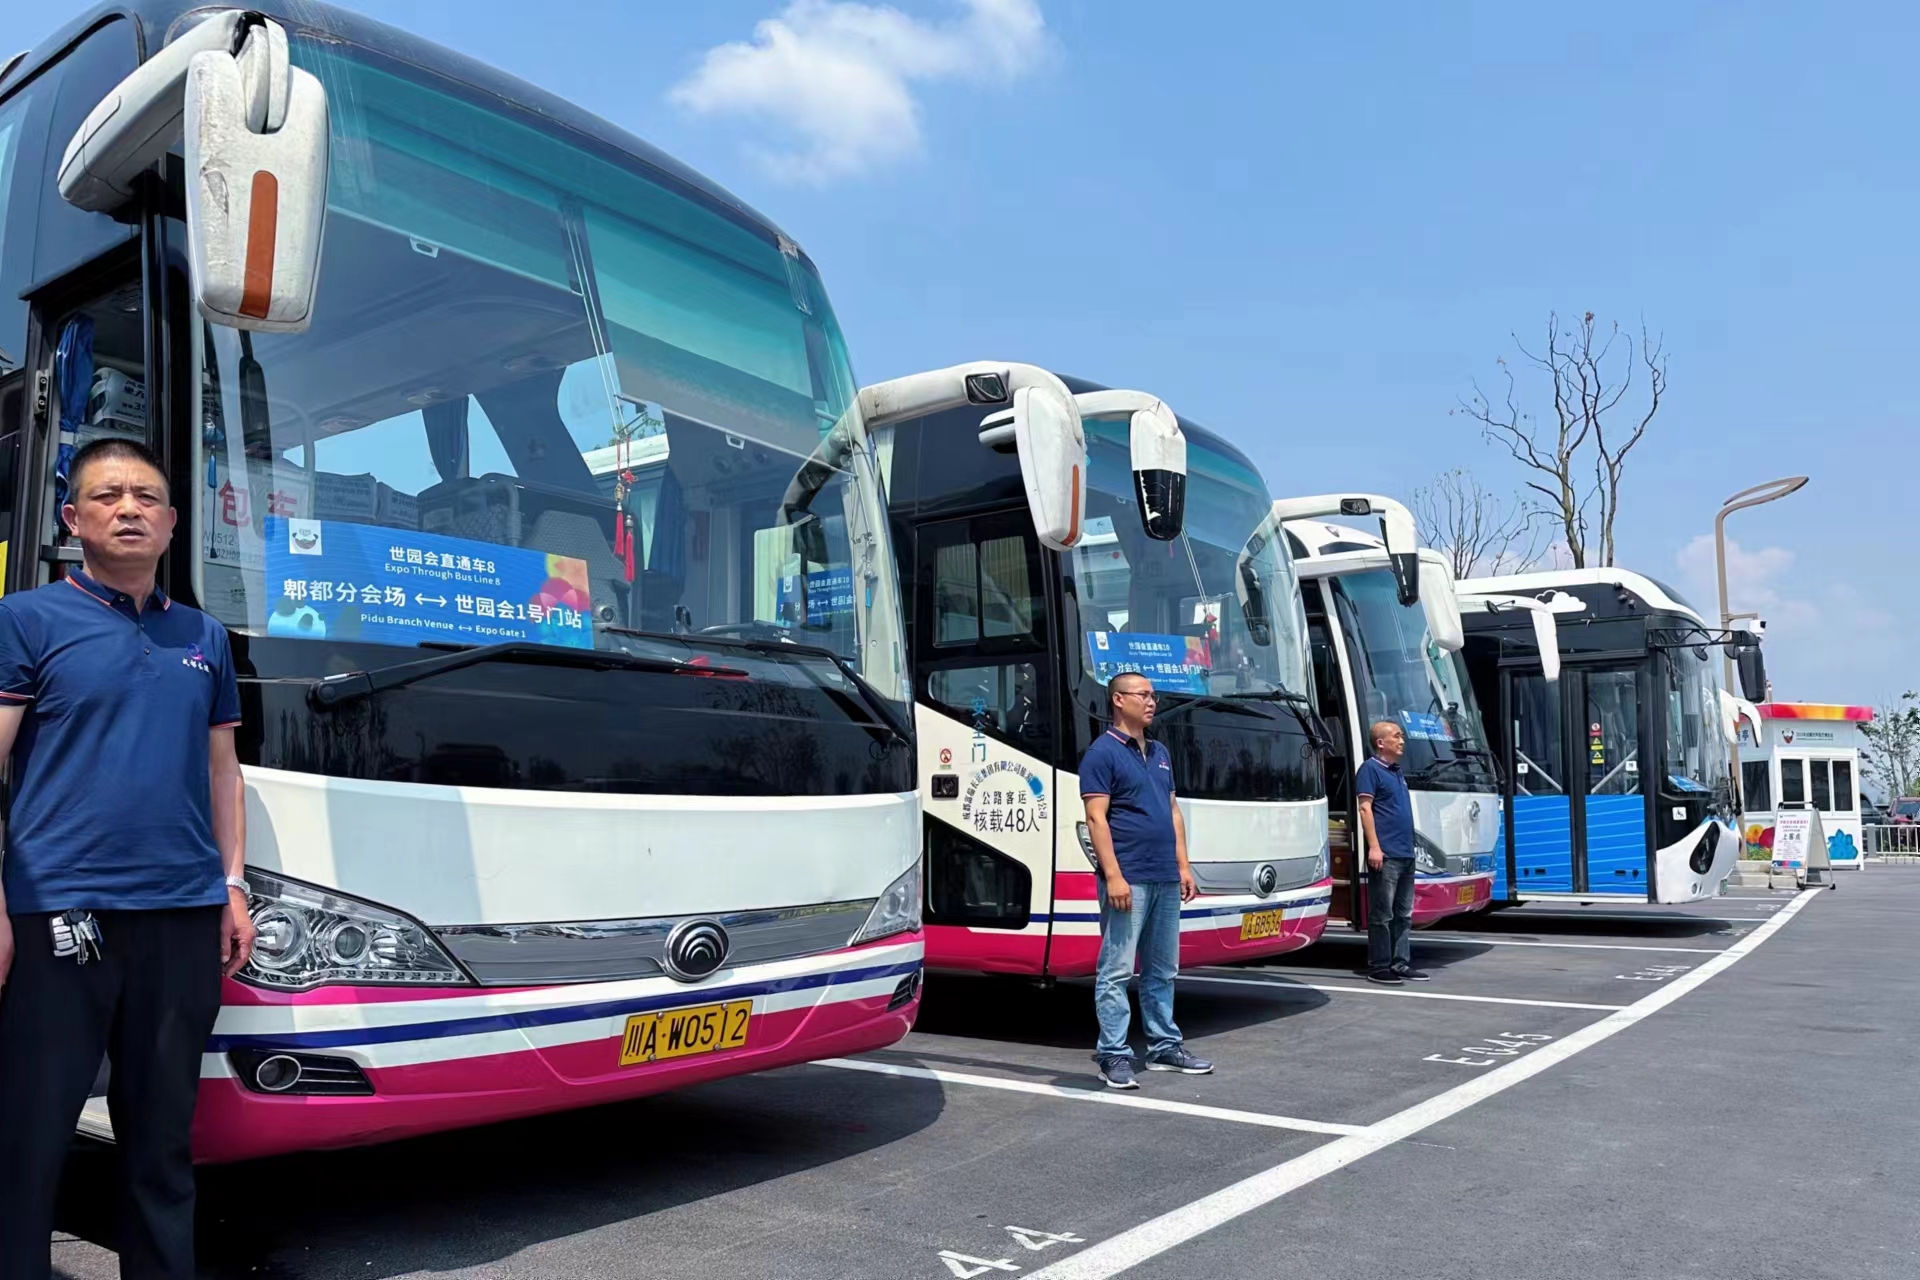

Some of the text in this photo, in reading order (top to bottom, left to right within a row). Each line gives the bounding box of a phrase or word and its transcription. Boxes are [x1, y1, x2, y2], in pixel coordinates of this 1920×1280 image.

[389, 545, 496, 574] 世园会直通车8
[384, 563, 501, 586] Expo Through Bus Line 8
[283, 578, 582, 629] 郫都分会场 世园会1号门站
[360, 613, 526, 638] Pidu Branch Venue Expo Gate 1
[982, 790, 1027, 805] 公路客运
[973, 808, 1040, 833] 核载48人
